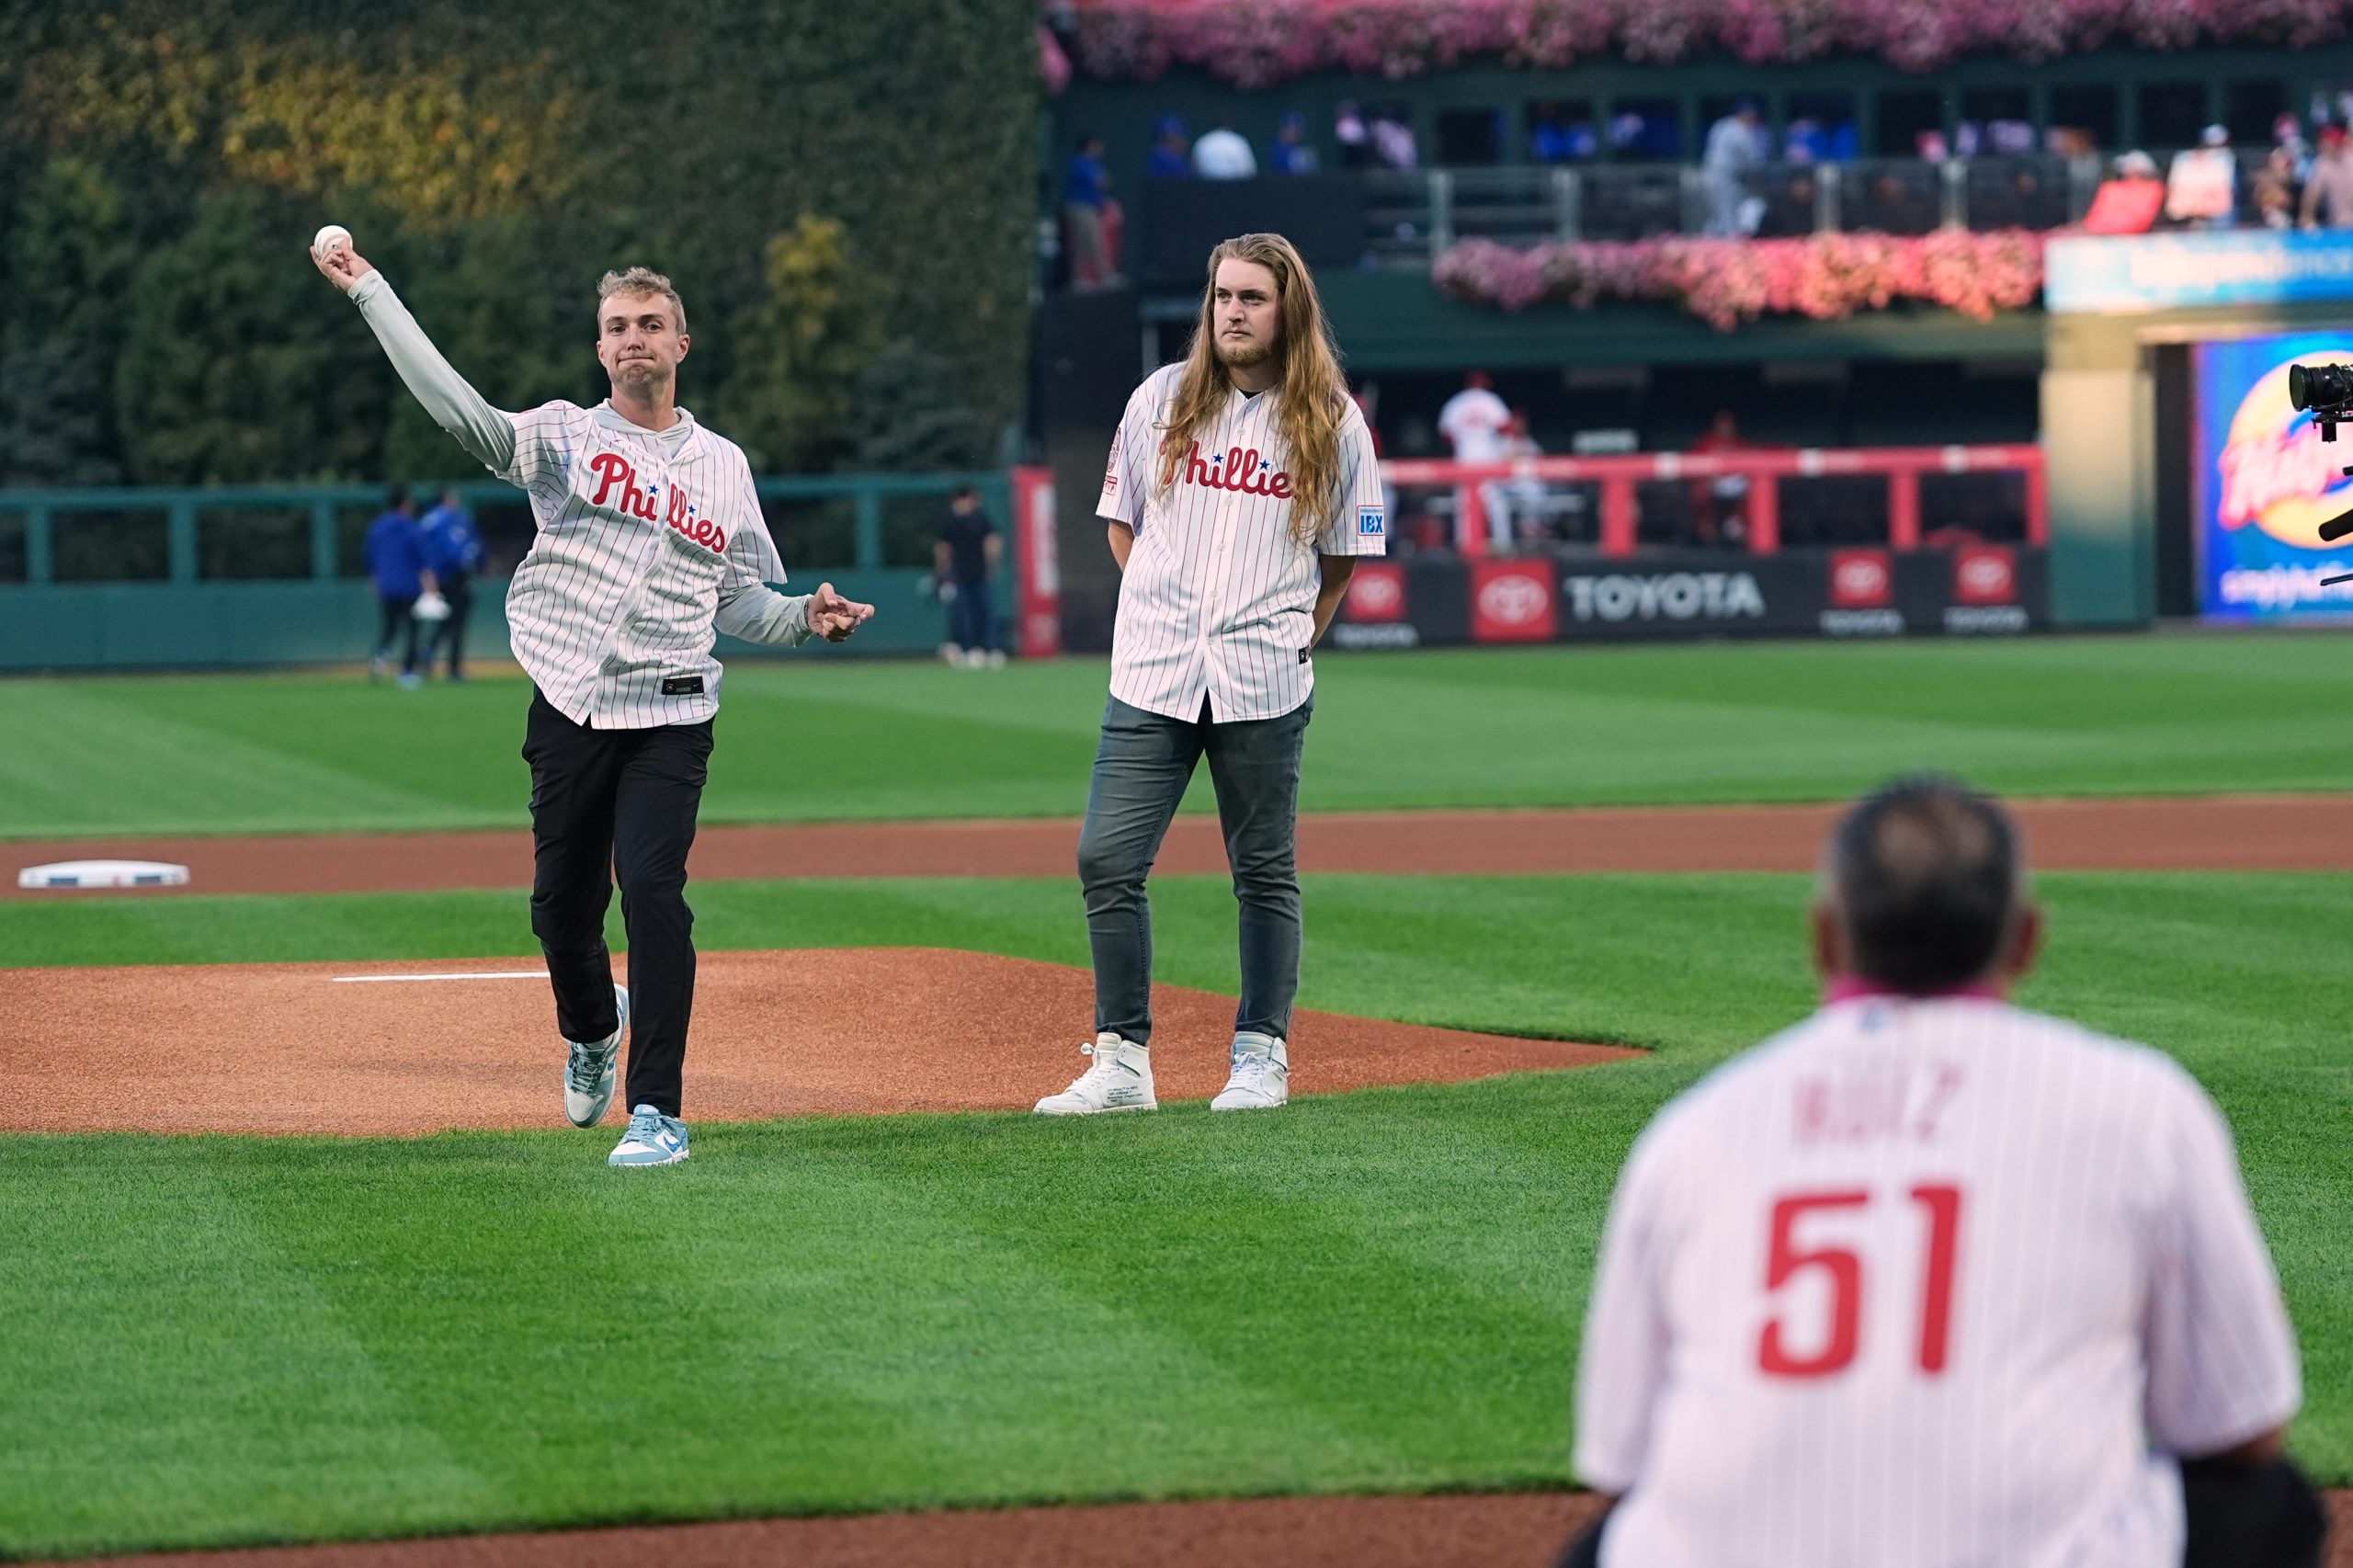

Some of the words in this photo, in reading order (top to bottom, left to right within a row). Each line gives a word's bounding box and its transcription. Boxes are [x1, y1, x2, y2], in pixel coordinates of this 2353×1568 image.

[590, 453, 725, 553] Phillies
[1359, 515, 1383, 533] IBX
[1564, 573, 1767, 620] TOYOTA
[1757, 1186, 1961, 1379] 51
